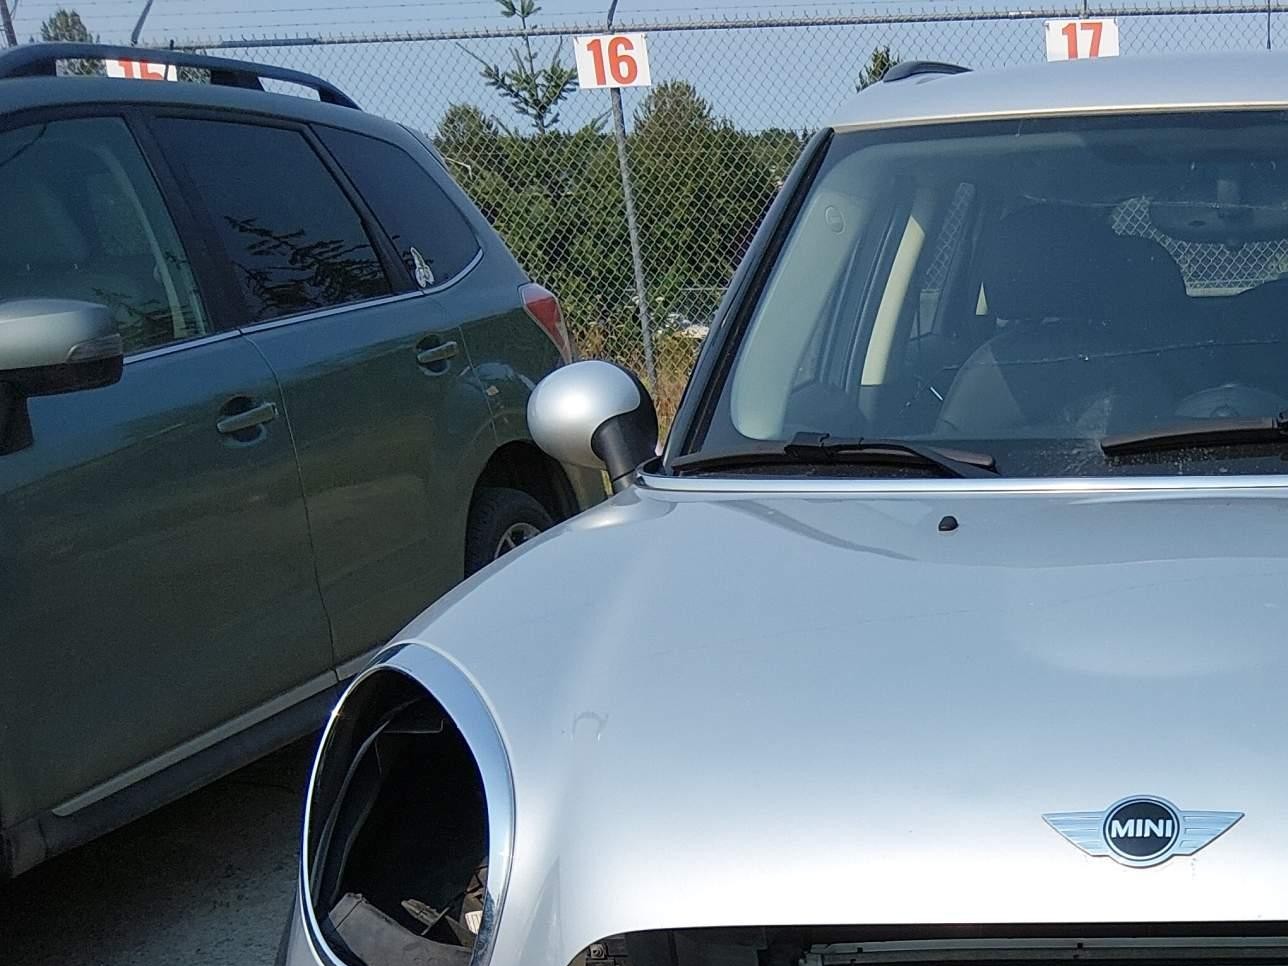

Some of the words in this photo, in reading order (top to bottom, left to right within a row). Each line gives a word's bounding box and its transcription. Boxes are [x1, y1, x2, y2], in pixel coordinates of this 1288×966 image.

[1061, 22, 1103, 59] 17
[586, 36, 638, 86] 16
[1111, 819, 1173, 838] MINI
